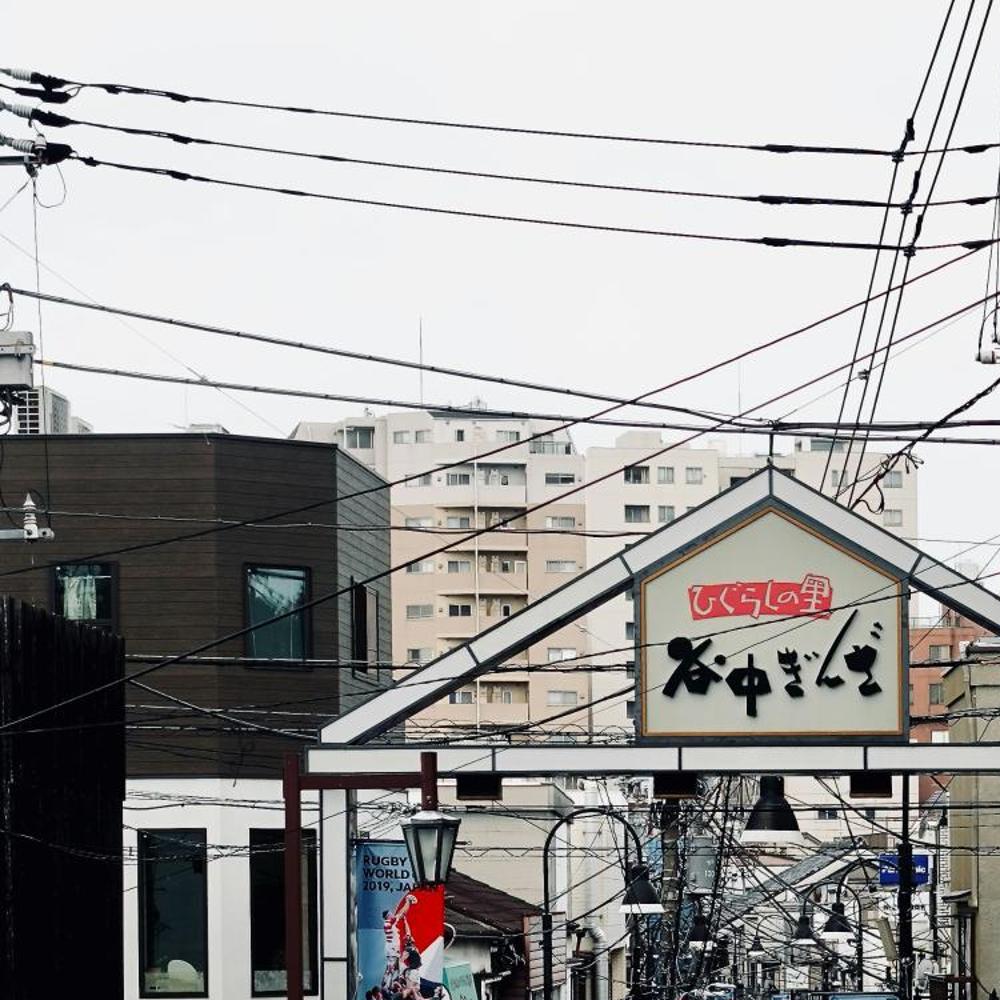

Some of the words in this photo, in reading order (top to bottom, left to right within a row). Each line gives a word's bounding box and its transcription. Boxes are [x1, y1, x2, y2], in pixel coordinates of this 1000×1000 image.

[690, 574, 831, 620] ひぐらしの里
[661, 608, 884, 719] 谷中ぎんざ
[363, 855, 408, 867] RUGBY
[363, 867, 410, 880] WORLD
[363, 881, 394, 894] 2019,
